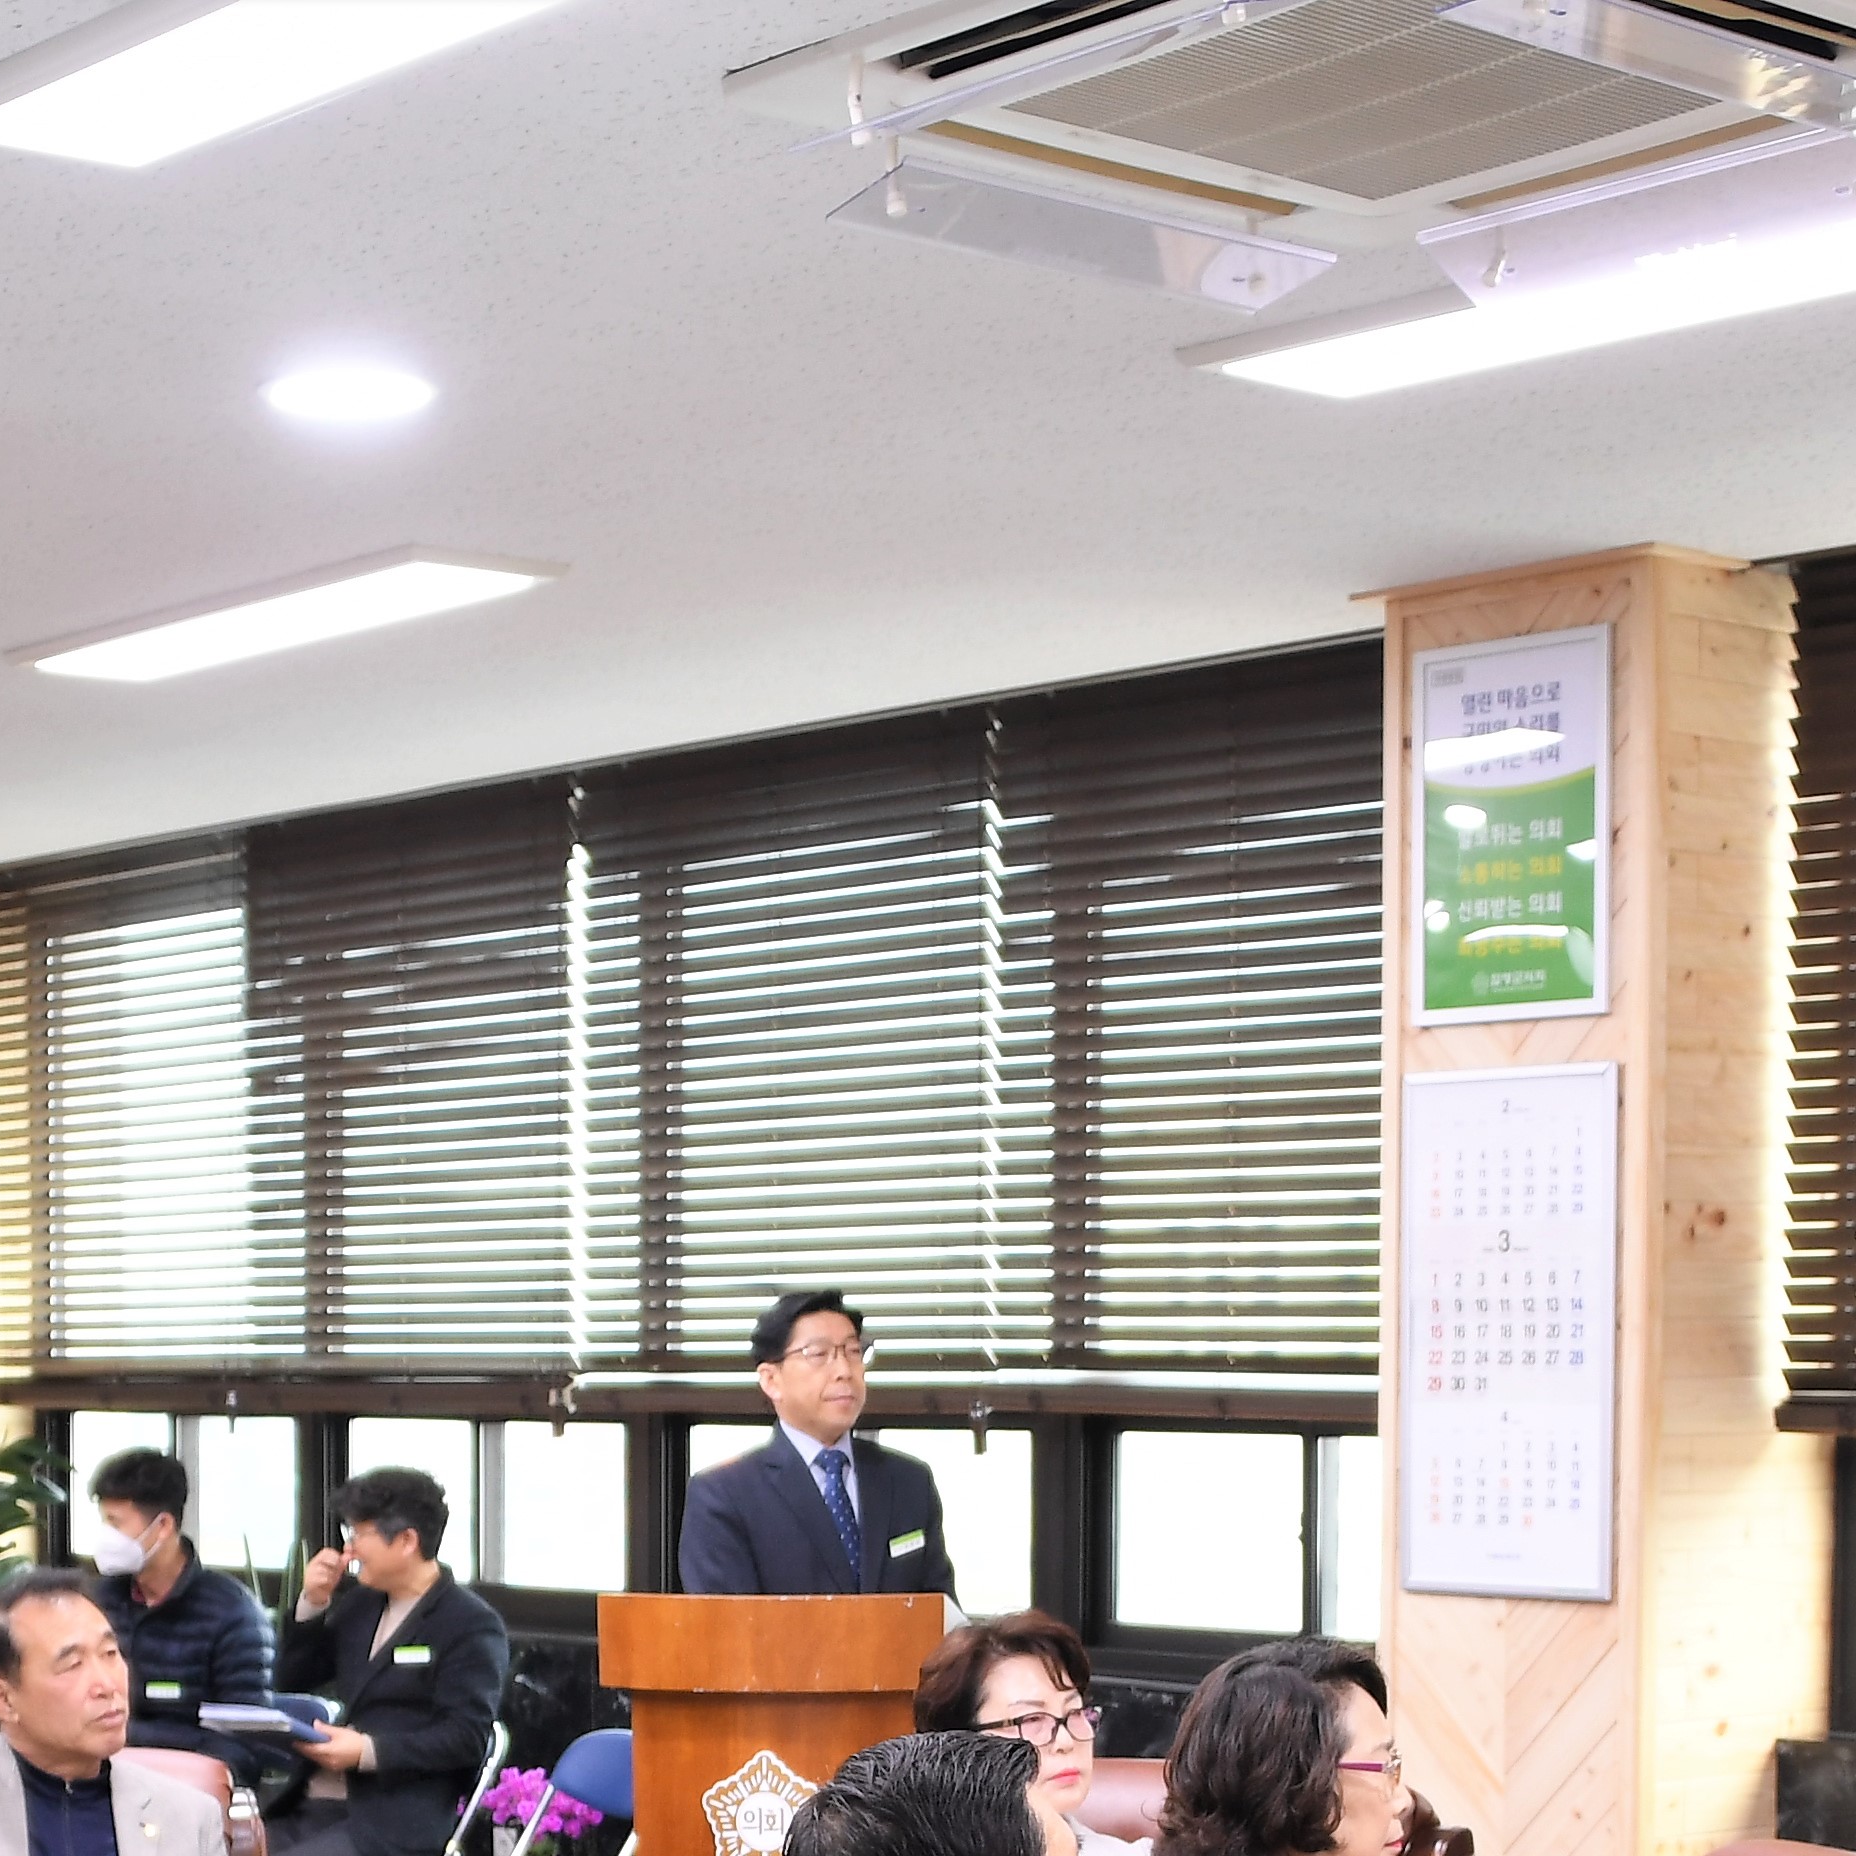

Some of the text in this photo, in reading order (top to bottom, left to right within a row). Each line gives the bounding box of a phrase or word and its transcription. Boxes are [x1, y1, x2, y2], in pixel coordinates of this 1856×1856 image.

[1461, 681, 1560, 716] 열린 마음으로
[1498, 1229, 1511, 1253] 3
[1475, 1298, 1488, 1313] 10
[1499, 1298, 1512, 1313] 11
[1523, 1297, 1535, 1312] 12
[1547, 1297, 1559, 1312] 13
[1570, 1297, 1583, 1312] 14
[1430, 1323, 1584, 1339] 15 16 17 18 19 20 21
[1428, 1350, 1584, 1366] 22 23 24 25 26 27 28
[1428, 1376, 1488, 1392] 29 30 31
[741, 1806, 785, 1836] 의회
